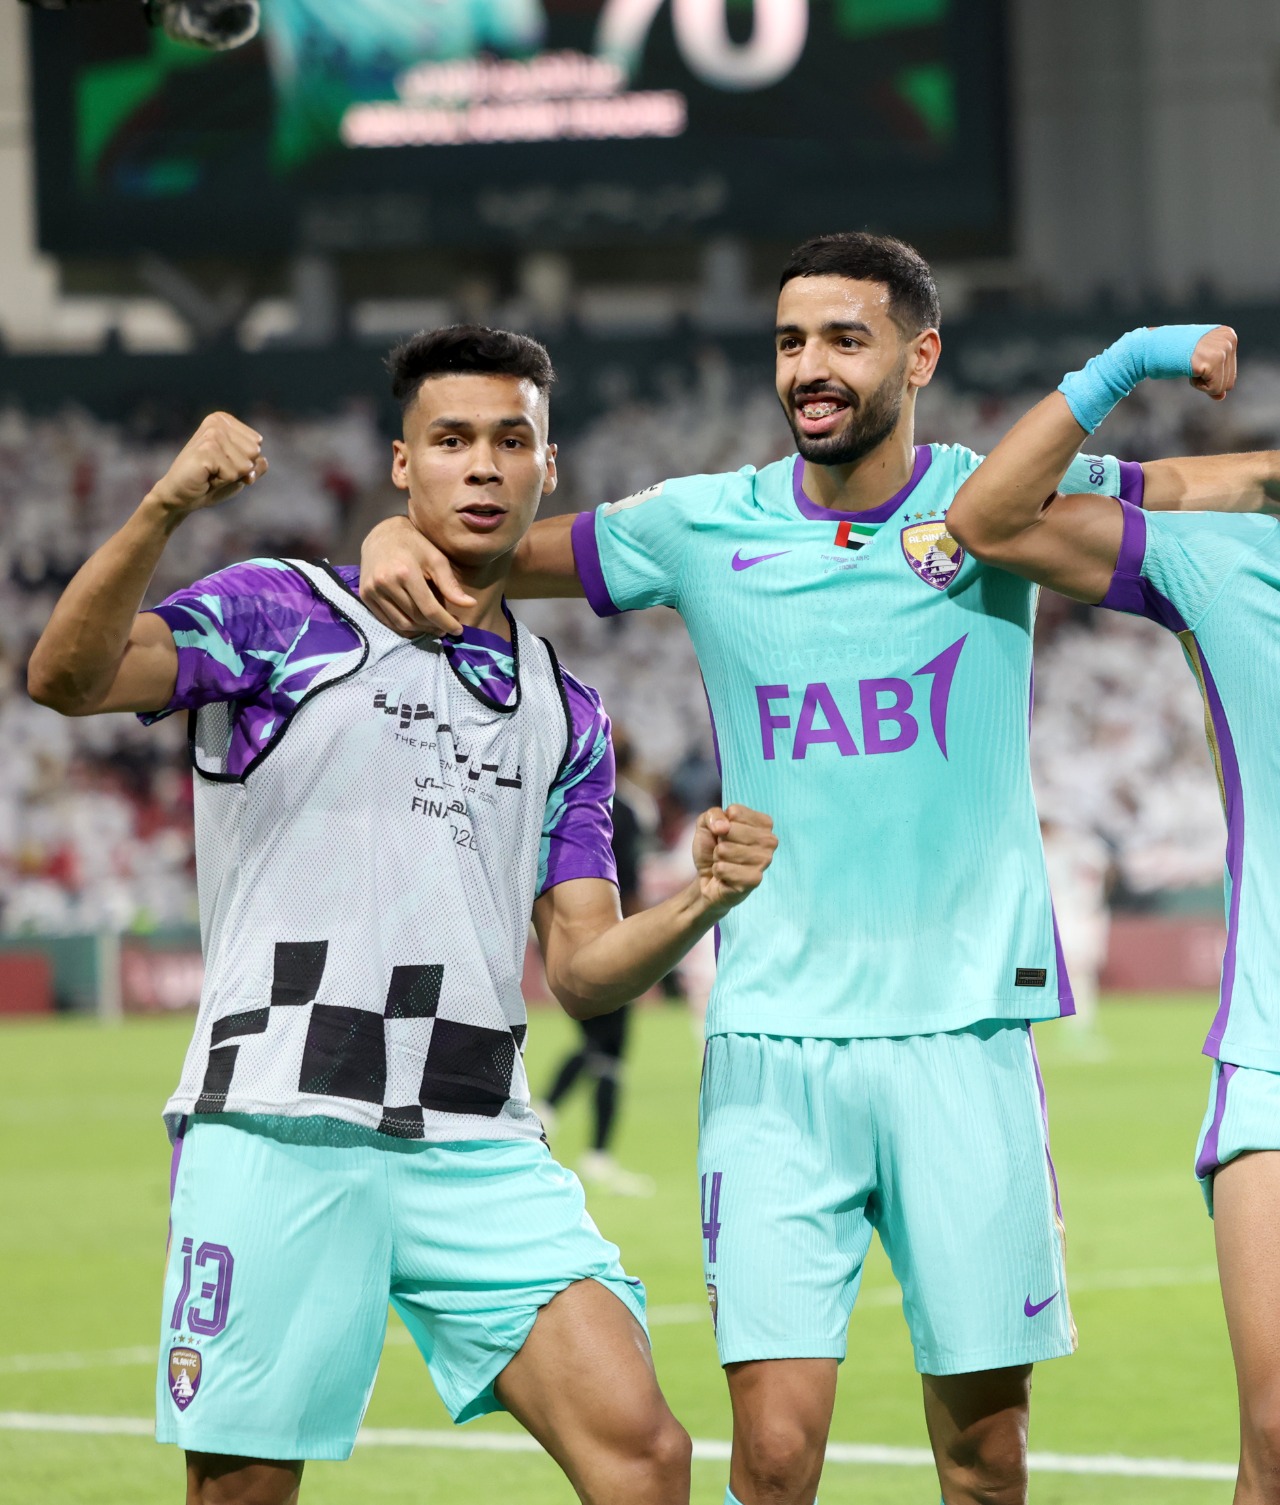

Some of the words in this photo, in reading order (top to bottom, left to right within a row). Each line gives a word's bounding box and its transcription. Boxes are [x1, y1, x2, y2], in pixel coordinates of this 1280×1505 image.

[394, 732, 417, 748] THE
[411, 796, 449, 820] FIN
[701, 1172, 723, 1263] 4
[170, 1236, 235, 1337] 13
